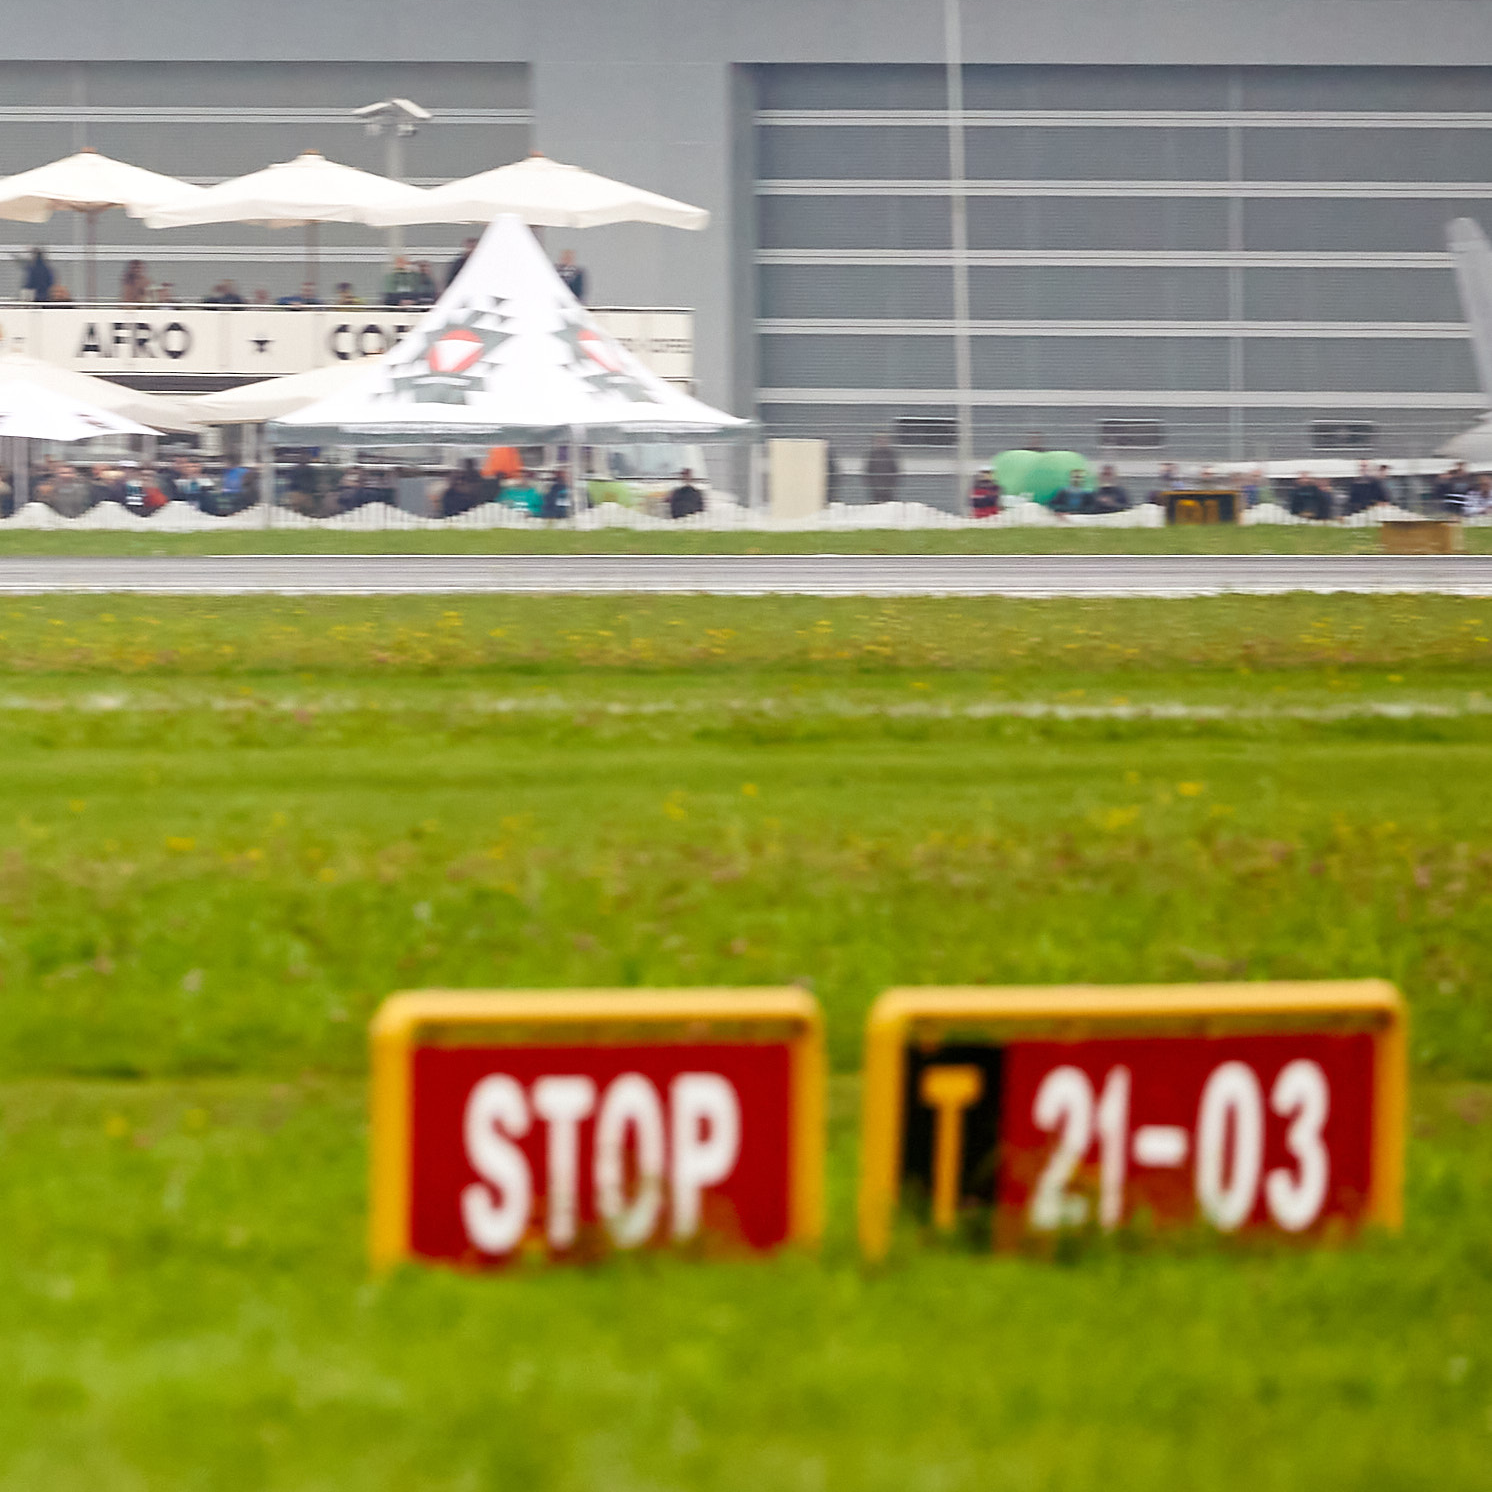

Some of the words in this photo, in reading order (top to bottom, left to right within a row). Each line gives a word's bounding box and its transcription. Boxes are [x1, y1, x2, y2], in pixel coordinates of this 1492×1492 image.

[74, 322, 193, 359] AFRO
[459, 1071, 744, 1255] STOP
[919, 1062, 985, 1230] T
[1028, 1057, 1332, 1232] 21-03
